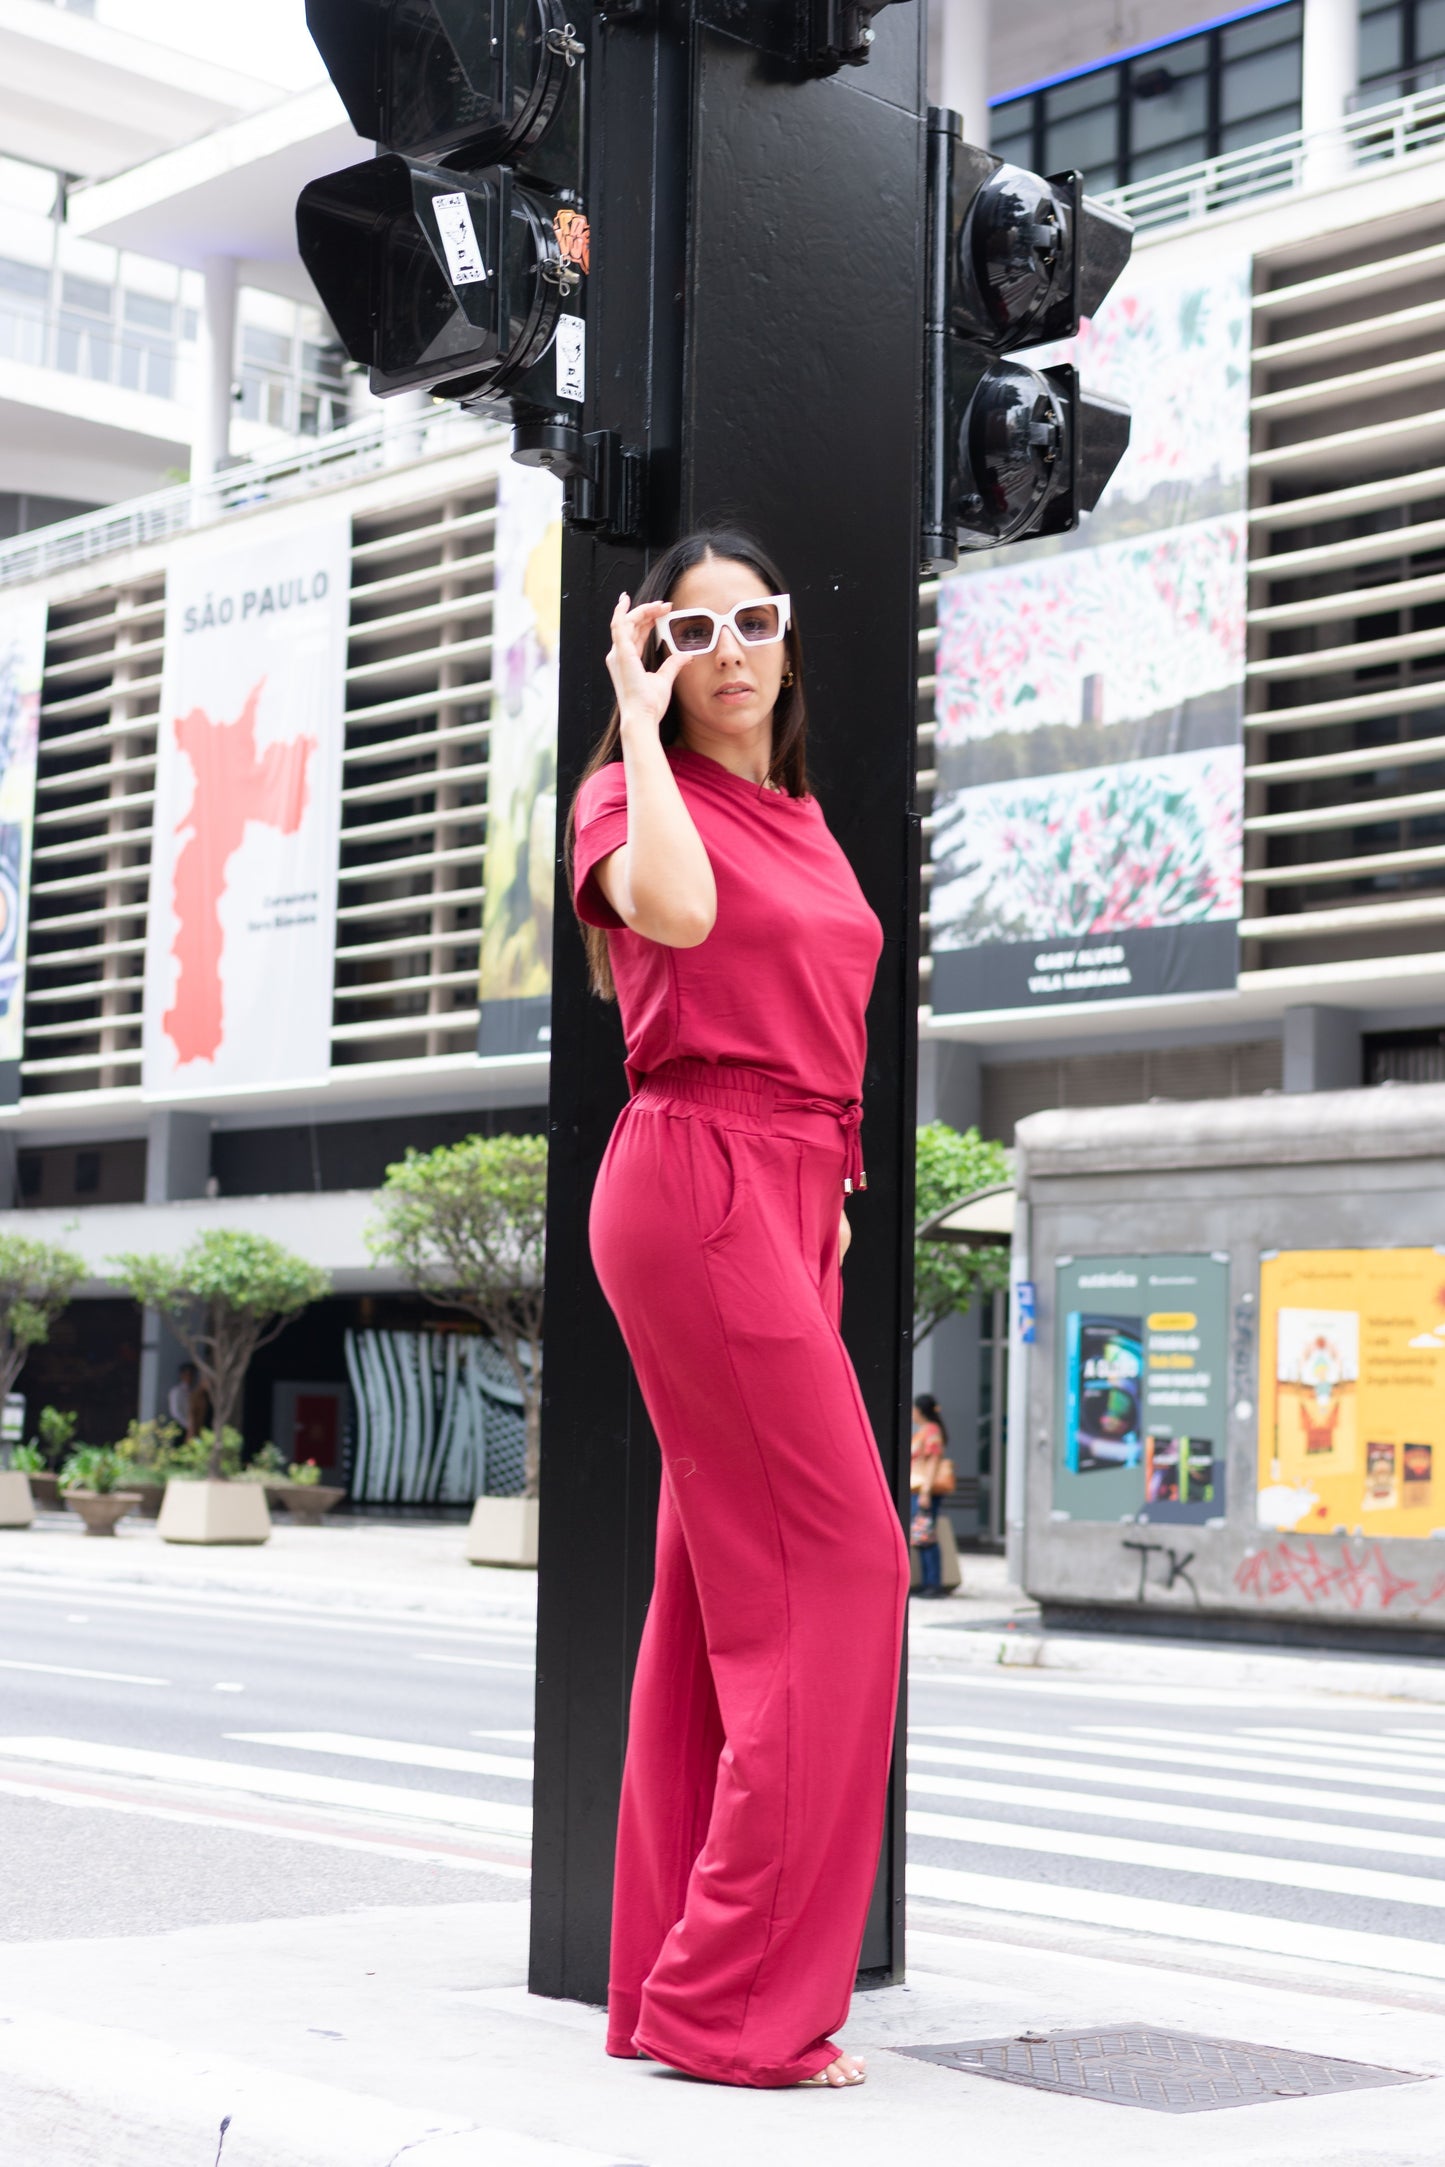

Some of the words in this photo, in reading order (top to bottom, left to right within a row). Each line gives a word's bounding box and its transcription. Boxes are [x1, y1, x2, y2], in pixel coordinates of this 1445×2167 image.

[242, 571, 328, 619] PAULO
[1028, 974, 1062, 993] VILA
[1122, 1541, 1201, 1608] TK
